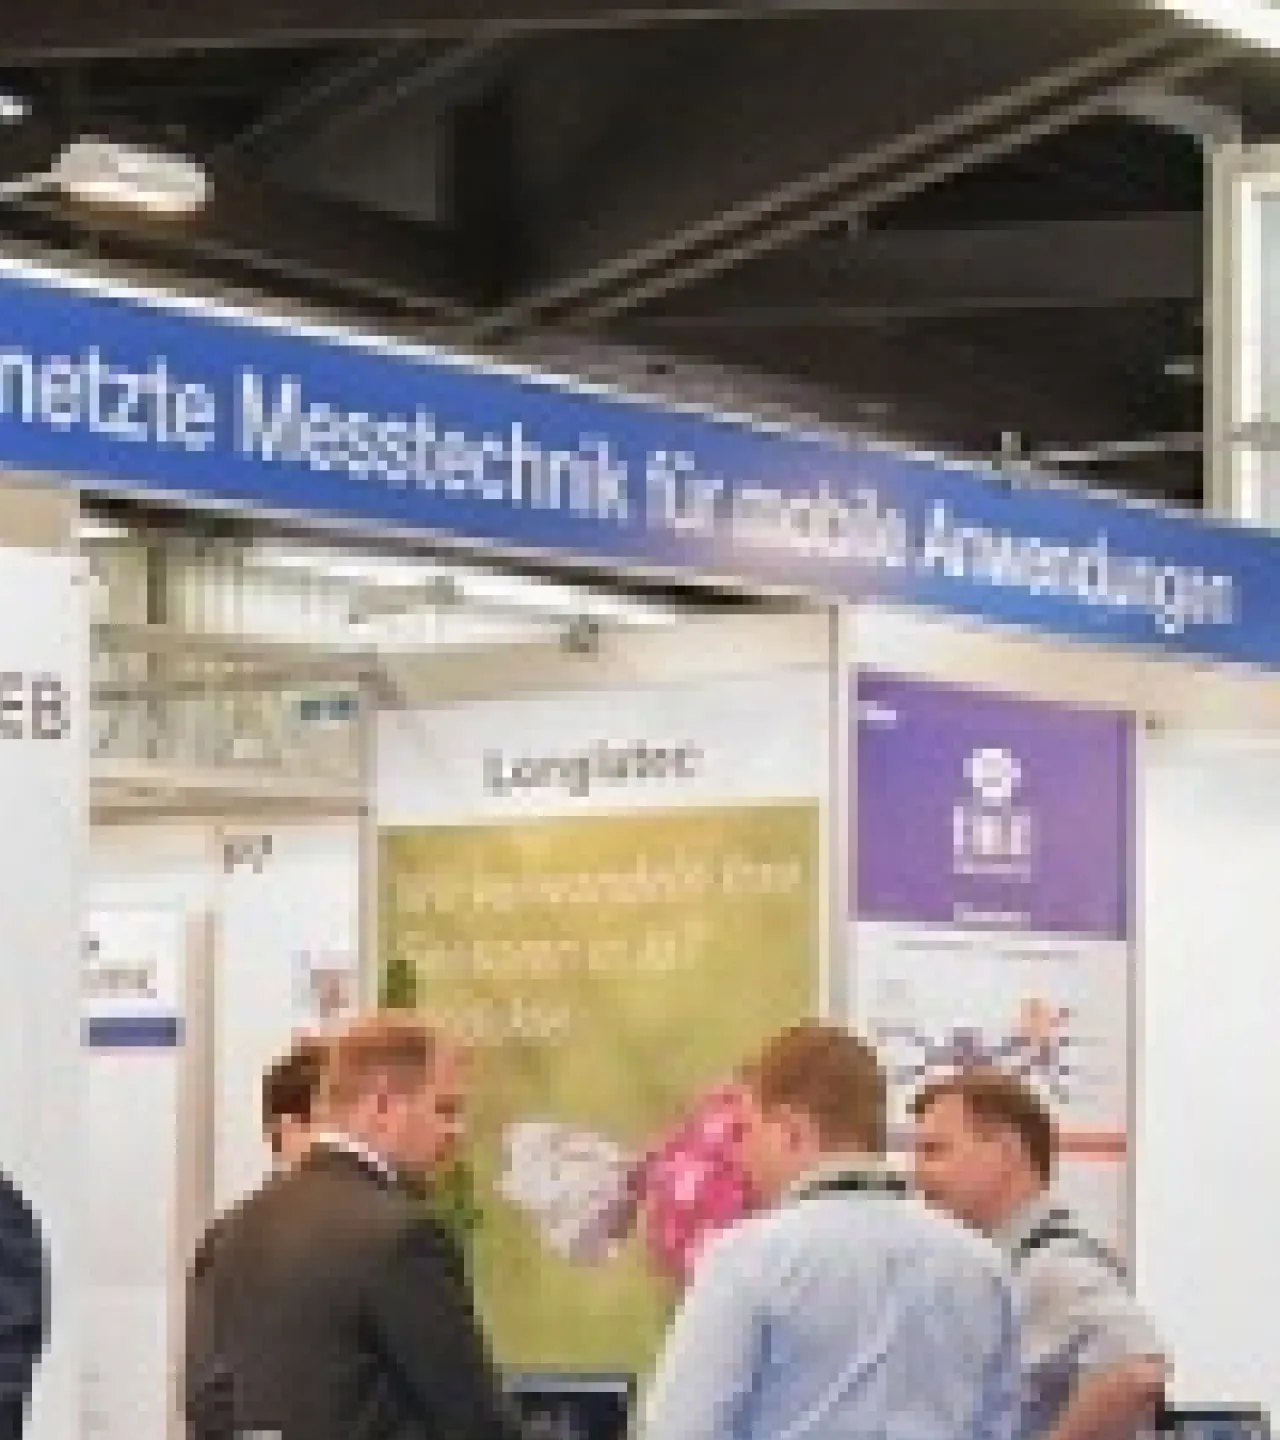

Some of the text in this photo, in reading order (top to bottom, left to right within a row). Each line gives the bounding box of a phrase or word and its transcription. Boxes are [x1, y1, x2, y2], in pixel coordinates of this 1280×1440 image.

[236, 364, 628, 522] Messtechnik
[646, 448, 724, 538] für
[732, 480, 907, 568] mobile
[924, 498, 1236, 636] Anwendungen
